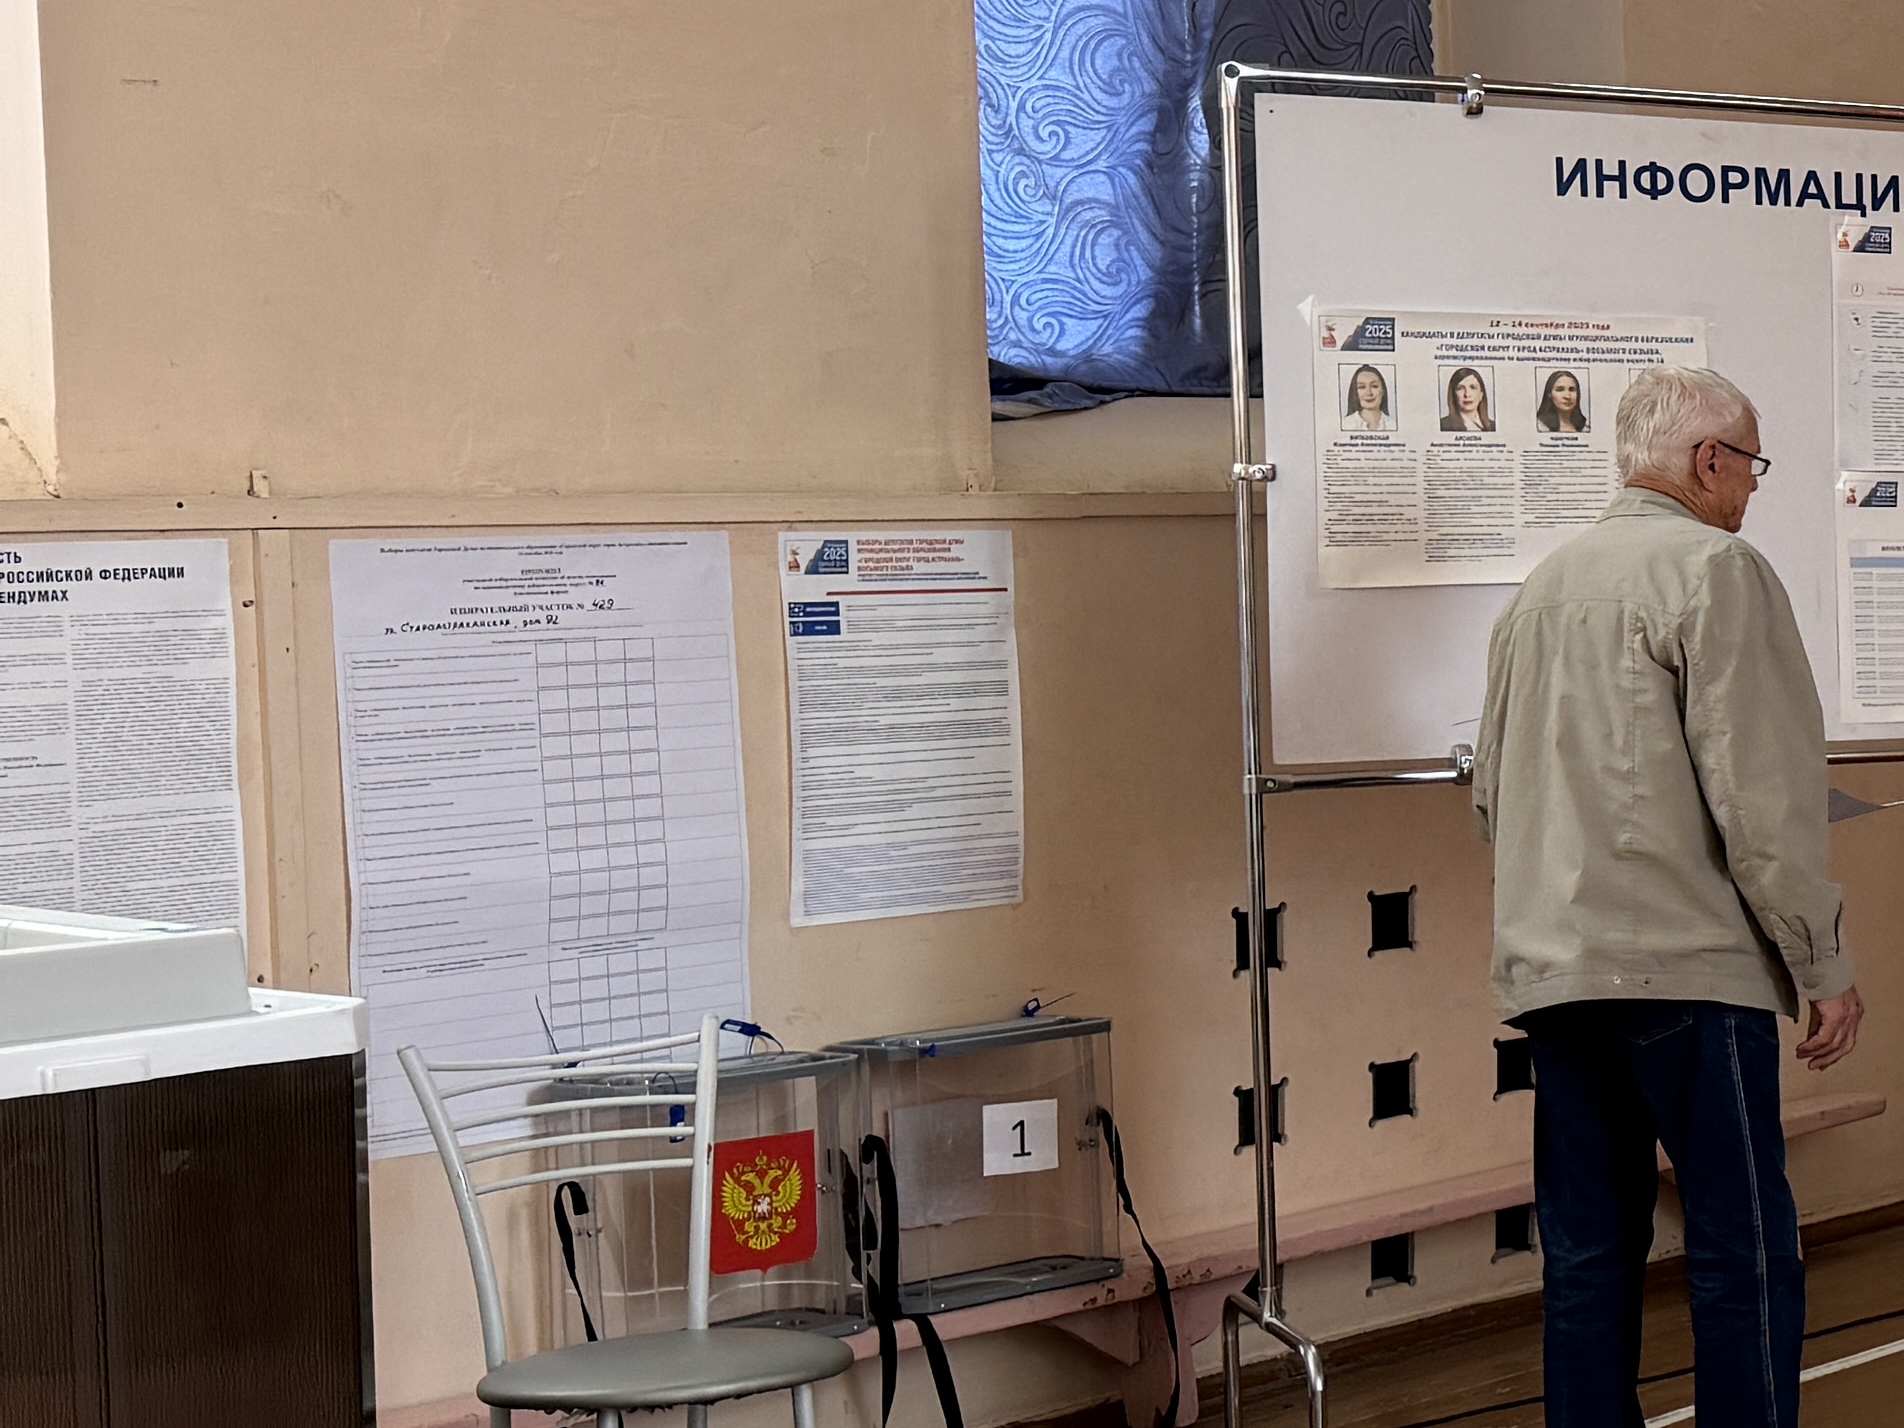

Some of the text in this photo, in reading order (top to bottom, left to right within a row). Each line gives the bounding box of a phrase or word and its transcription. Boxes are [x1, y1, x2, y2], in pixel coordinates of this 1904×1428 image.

[1364, 324, 1393, 338] 2025
[824, 548, 847, 560] 2025
[0, 566, 185, 584] РОССИЙСКОЙ ФЕДЕРАЦИИ
[0, 590, 69, 605] ЕНДУМАХ
[592, 598, 614, 610] 429
[1010, 1119, 1032, 1158] 1
